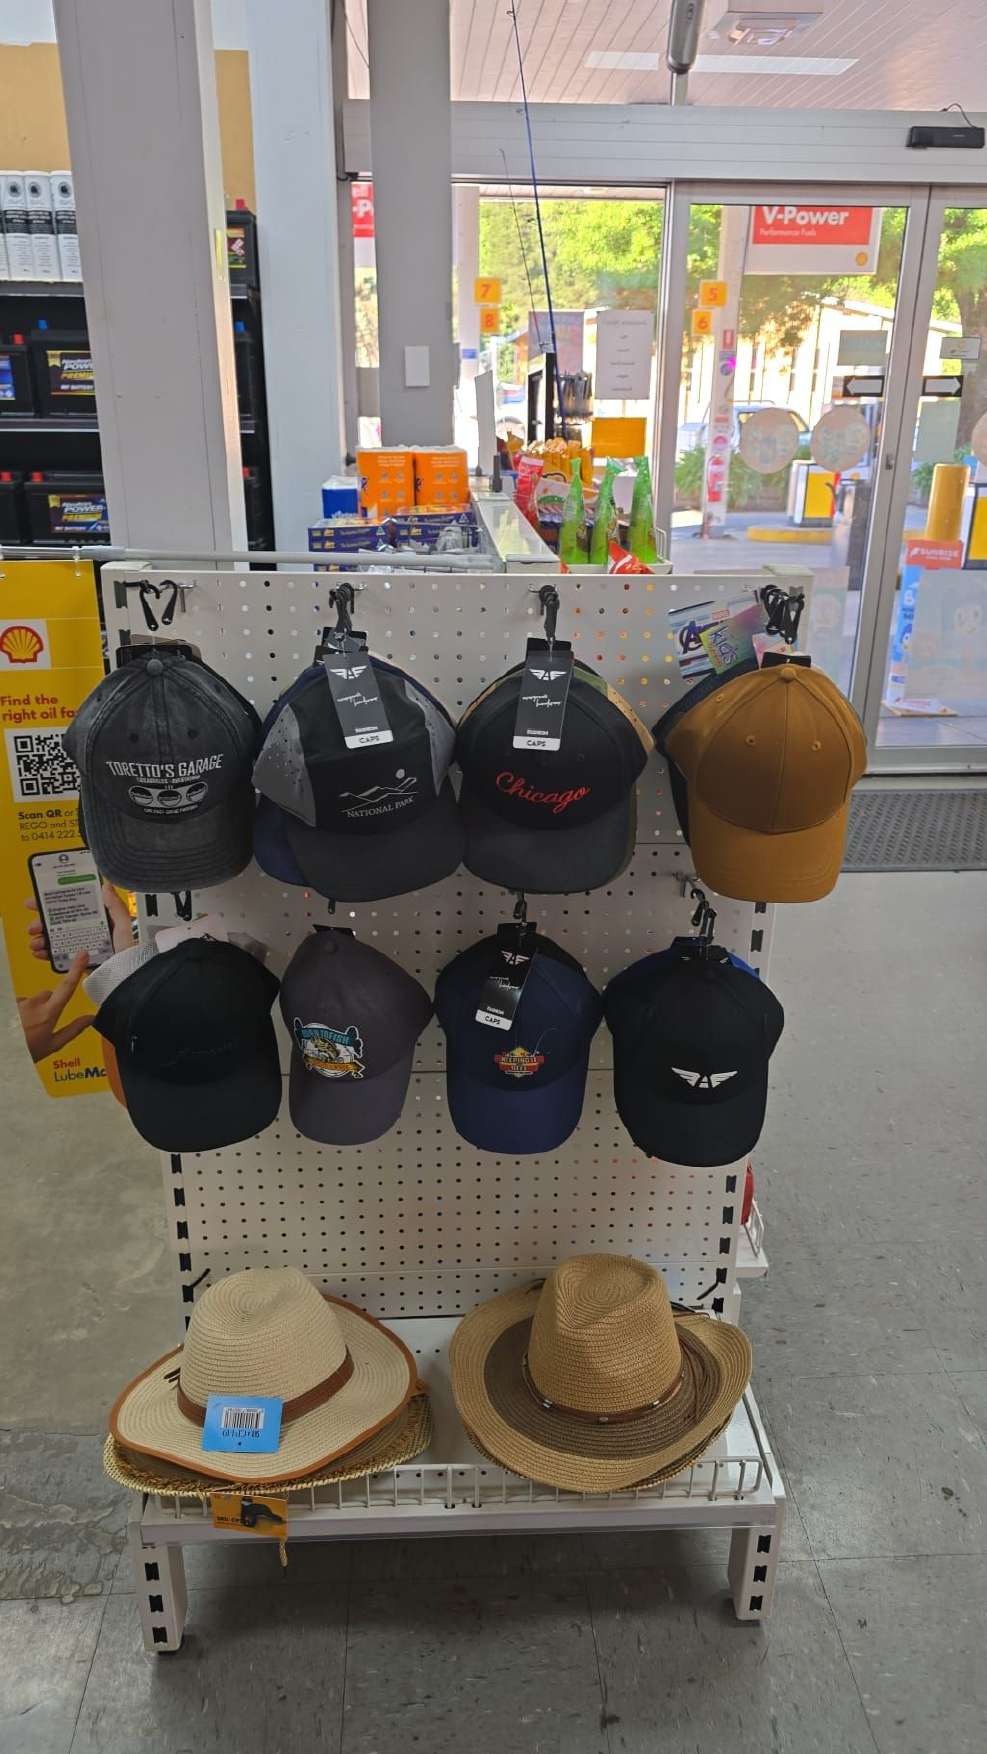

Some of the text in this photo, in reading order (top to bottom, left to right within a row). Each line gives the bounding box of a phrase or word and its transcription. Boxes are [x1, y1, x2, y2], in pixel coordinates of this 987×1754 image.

[762, 206, 849, 225] V-Power
[481, 284, 492, 298] 7
[708, 288, 718, 302] 5
[484, 314, 495, 328] 8
[698, 316, 708, 330] 6
[1, 693, 58, 706] Find the
[3, 709, 37, 724] right
[40, 708, 57, 720] oil
[359, 735, 379, 744] CAPS
[526, 739, 547, 748] CAPS
[106, 753, 224, 778] TORETTO'S GARAGE
[496, 771, 591, 814] Chicago
[347, 796, 414, 818] NATIONAL PARK
[18, 811, 44, 821] Scan
[46, 809, 62, 819] QR
[50, 820, 67, 830] and
[21, 832, 29, 843] to
[484, 1015, 501, 1025] CAPS
[53, 1055, 80, 1069] Shell
